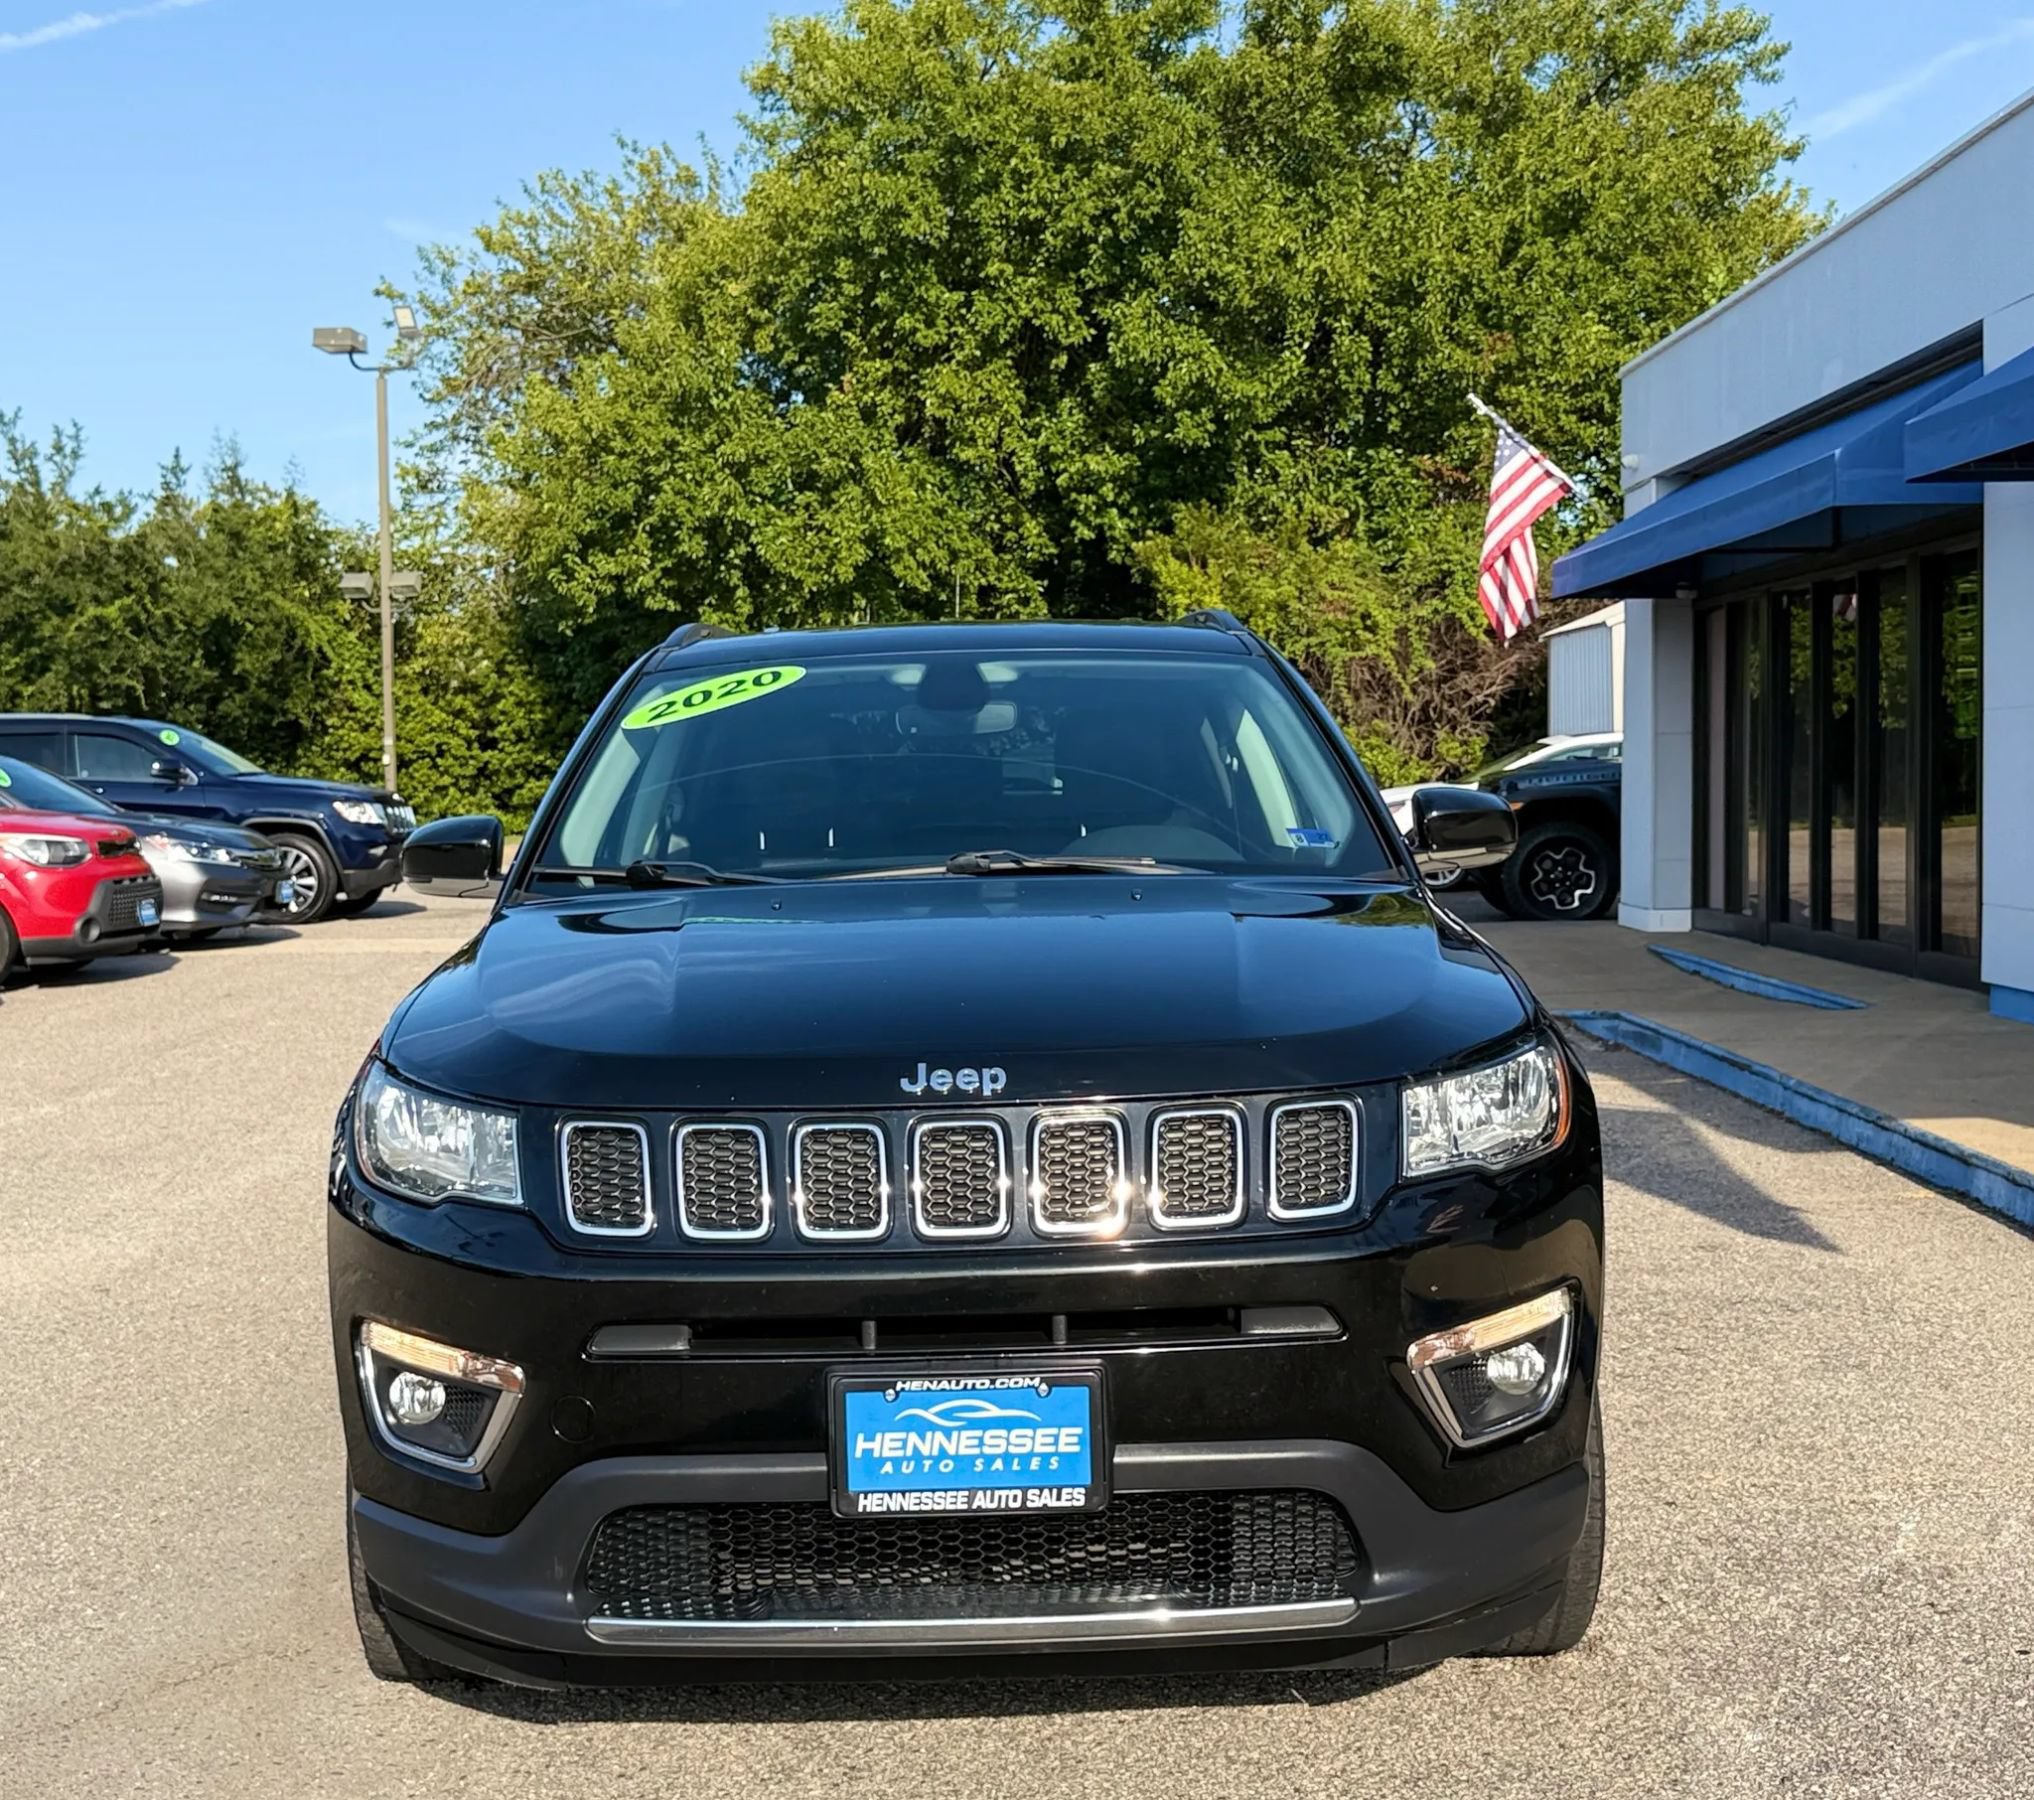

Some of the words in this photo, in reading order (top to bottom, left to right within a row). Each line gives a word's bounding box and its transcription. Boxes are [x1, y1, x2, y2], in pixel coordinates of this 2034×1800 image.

[646, 670, 783, 723] 2020
[899, 1062, 1007, 1096] Jeep
[894, 1376, 1041, 1392] HENAUTO.COM
[854, 1427, 1083, 1458] HENNESSEE
[880, 1459, 954, 1474] AUTO
[973, 1456, 1060, 1472] SALES
[857, 1491, 969, 1512] HENNESSEE
[971, 1489, 1022, 1509] AUTO
[1026, 1487, 1086, 1507] SALES
